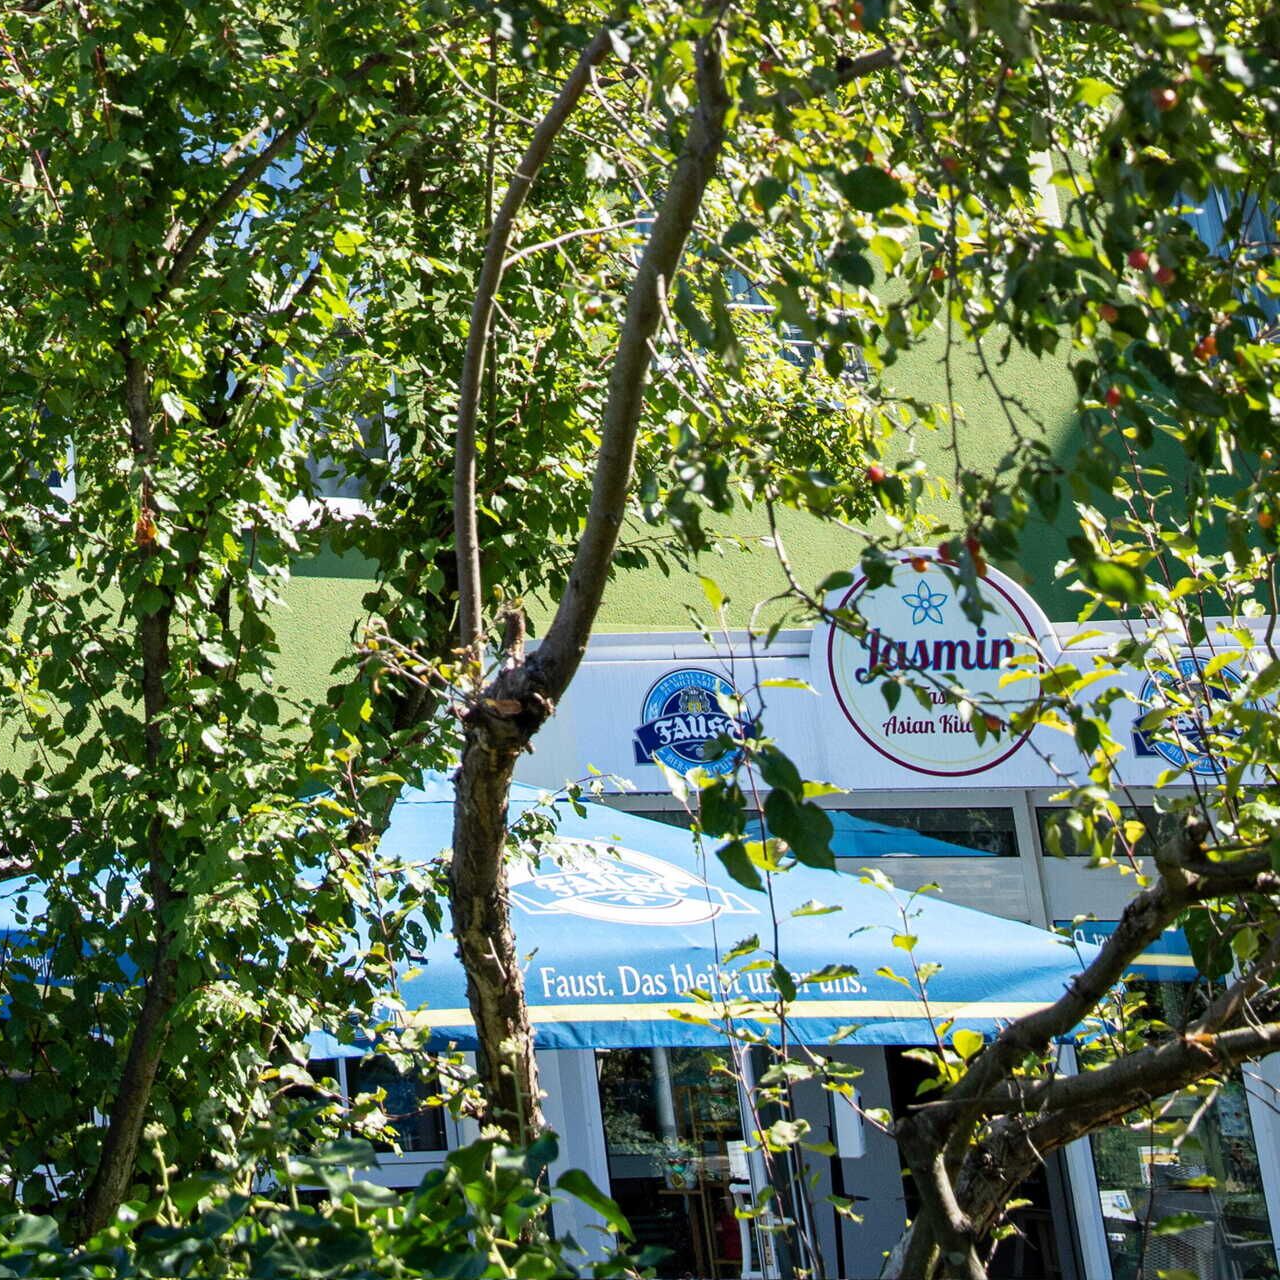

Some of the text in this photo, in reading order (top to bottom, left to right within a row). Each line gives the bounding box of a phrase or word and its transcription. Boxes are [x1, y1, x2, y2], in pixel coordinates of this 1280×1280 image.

[855, 627, 1018, 684] Jasmin
[882, 715, 935, 736] Asian
[540, 966, 614, 997] Faust.
[617, 965, 668, 997] Das
[747, 970, 810, 994] uner
